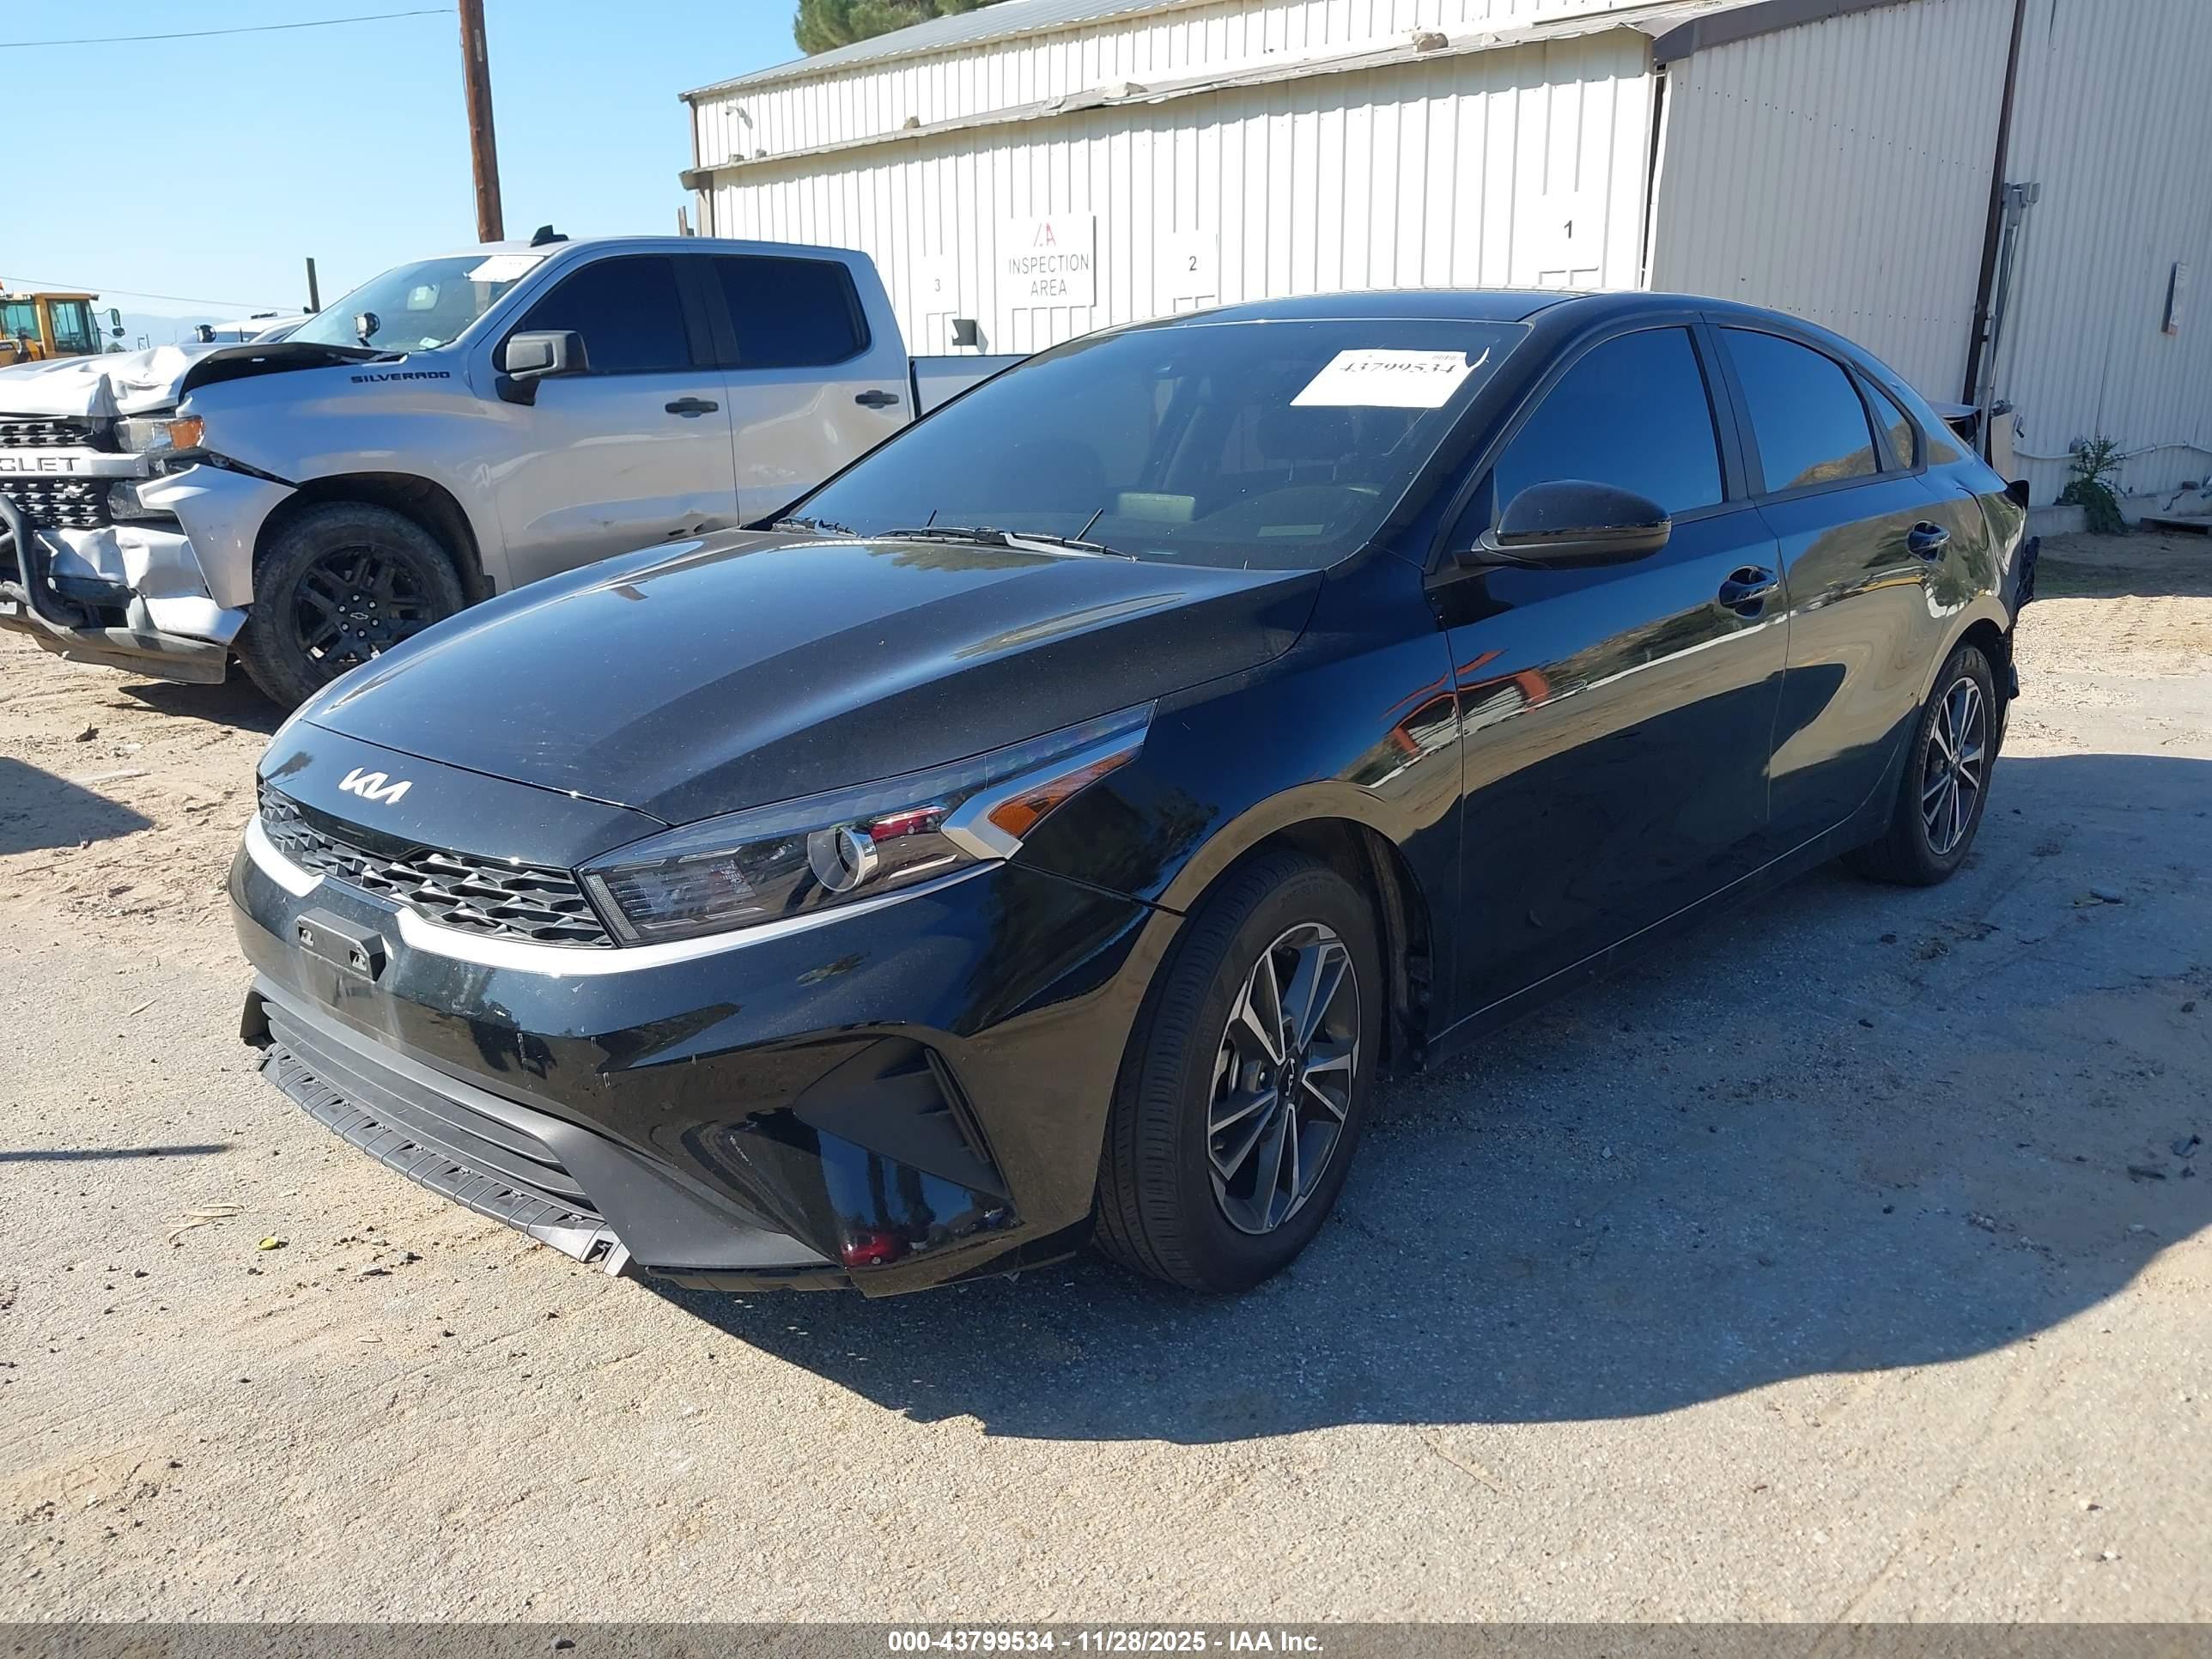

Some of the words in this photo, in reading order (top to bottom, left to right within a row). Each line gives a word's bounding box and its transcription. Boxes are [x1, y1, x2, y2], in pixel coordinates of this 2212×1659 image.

[1564, 220, 1572, 239] 1
[1009, 253, 1090, 275] INSPECTION
[1188, 255, 1197, 272] 2
[934, 278, 941, 292] 3
[1030, 278, 1067, 296] AREA
[350, 371, 451, 384] SILVERADO
[338, 767, 413, 805] KIA
